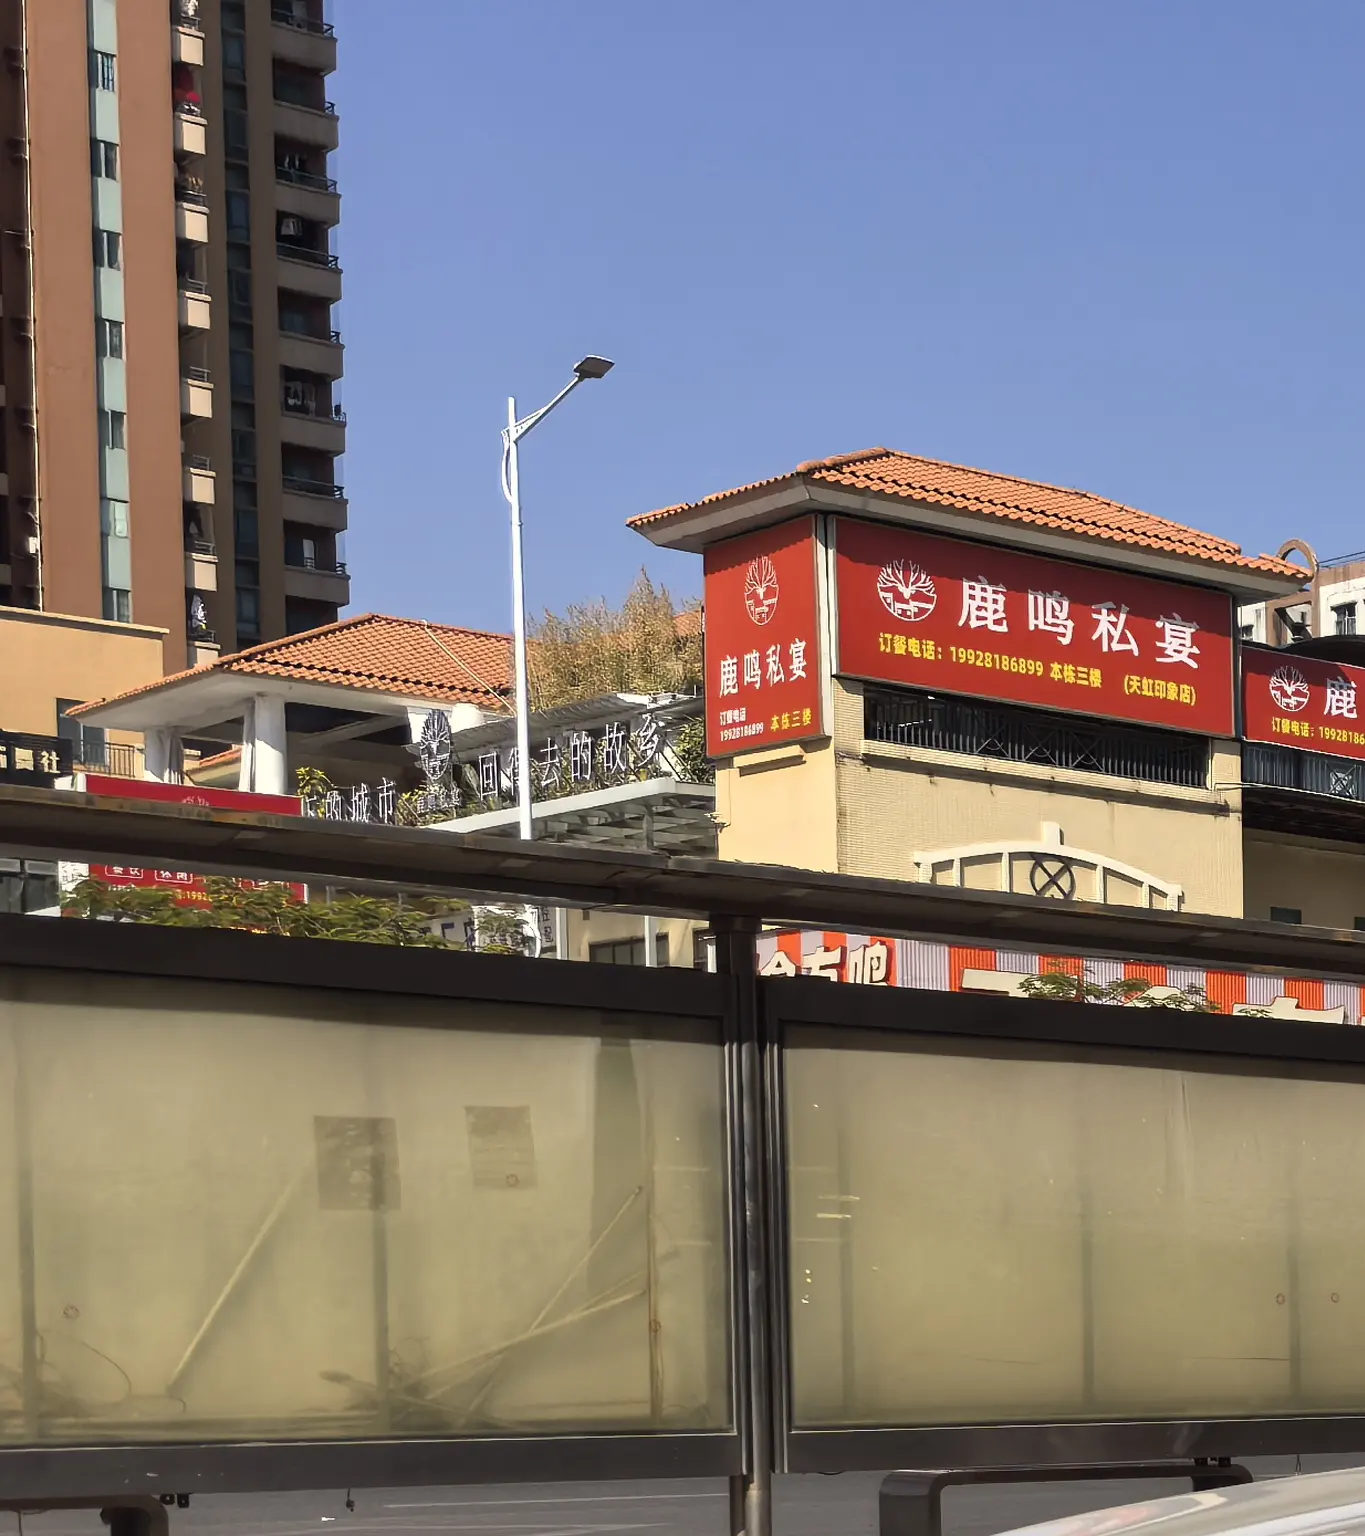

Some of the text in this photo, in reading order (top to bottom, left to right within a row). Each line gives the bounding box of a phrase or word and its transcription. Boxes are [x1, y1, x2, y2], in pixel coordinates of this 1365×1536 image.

[958, 575, 1200, 669] 鹿鸣私宴
[719, 637, 807, 698] 鹿鸣私宴
[1049, 661, 1103, 689] 本栋三楼
[1123, 673, 1197, 706] (天虹印象店)
